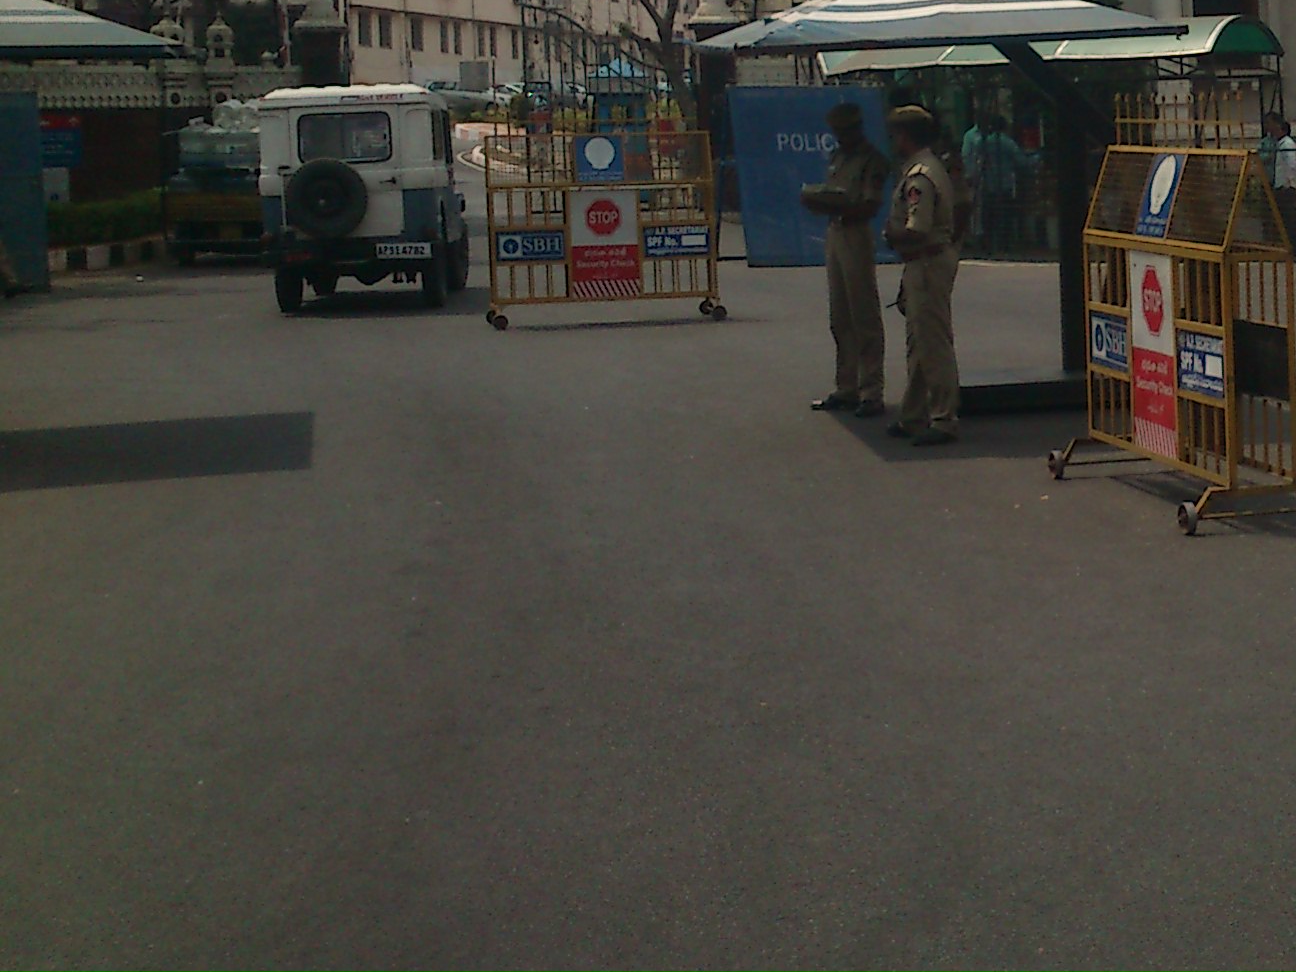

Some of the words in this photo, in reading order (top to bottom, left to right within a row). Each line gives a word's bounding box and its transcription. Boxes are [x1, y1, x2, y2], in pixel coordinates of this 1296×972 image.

[776, 132, 840, 152] POLIC
[588, 212, 618, 224] STOP
[522, 236, 561, 253] SBH
[647, 236, 663, 247] SPF
[576, 260, 609, 269] Security
[610, 259, 635, 267] Check
[1143, 288, 1162, 312] STOP
[1105, 329, 1126, 356] SBH
[1136, 376, 1158, 394] Security
[1158, 381, 1173, 395] Check
